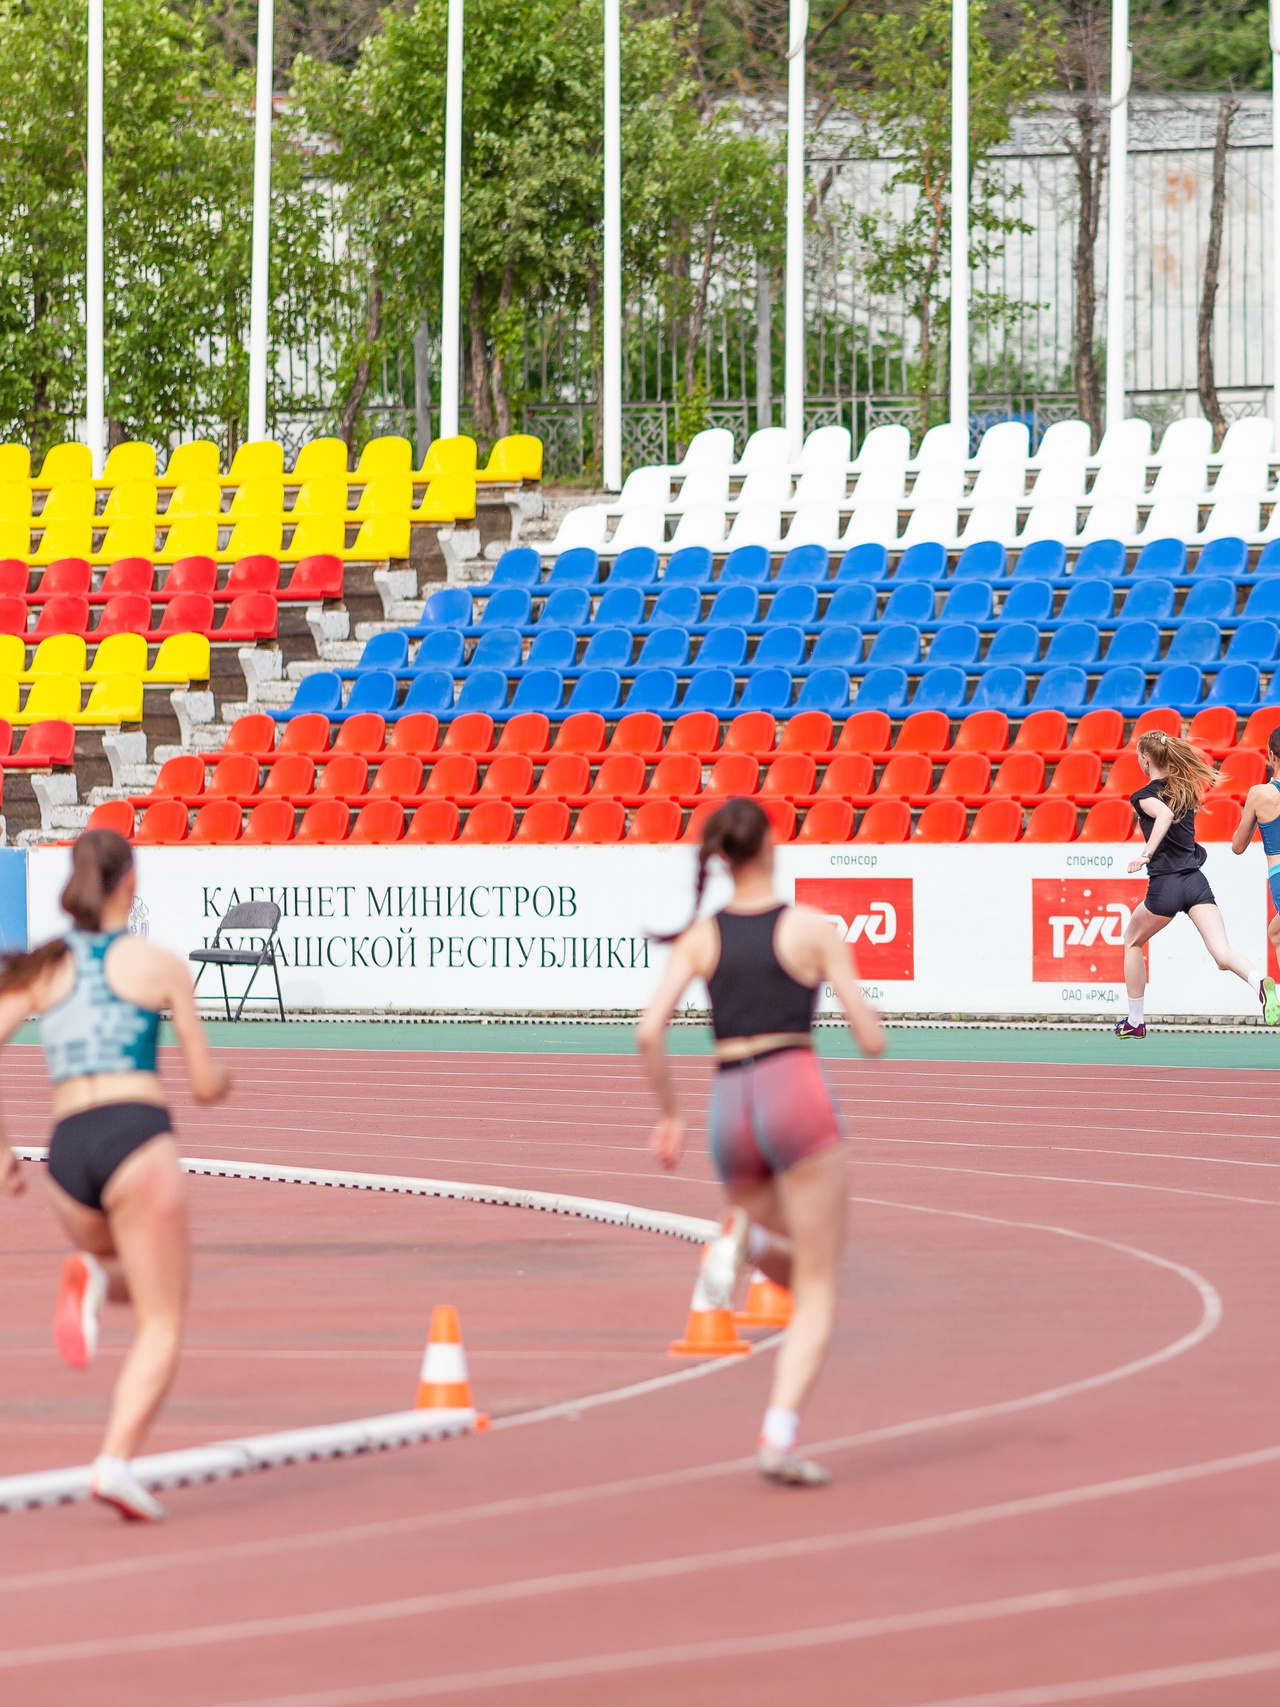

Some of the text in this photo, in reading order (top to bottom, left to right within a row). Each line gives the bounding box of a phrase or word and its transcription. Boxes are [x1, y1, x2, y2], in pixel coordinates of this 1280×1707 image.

[830, 855, 878, 868] спонсор
[1066, 855, 1114, 869] спонсор
[366, 885, 577, 917] МИНИСТРОВ
[427, 935, 651, 968] РЕСПУБЛИКИ
[1061, 988, 1120, 1003] ОАО «РЖД»
